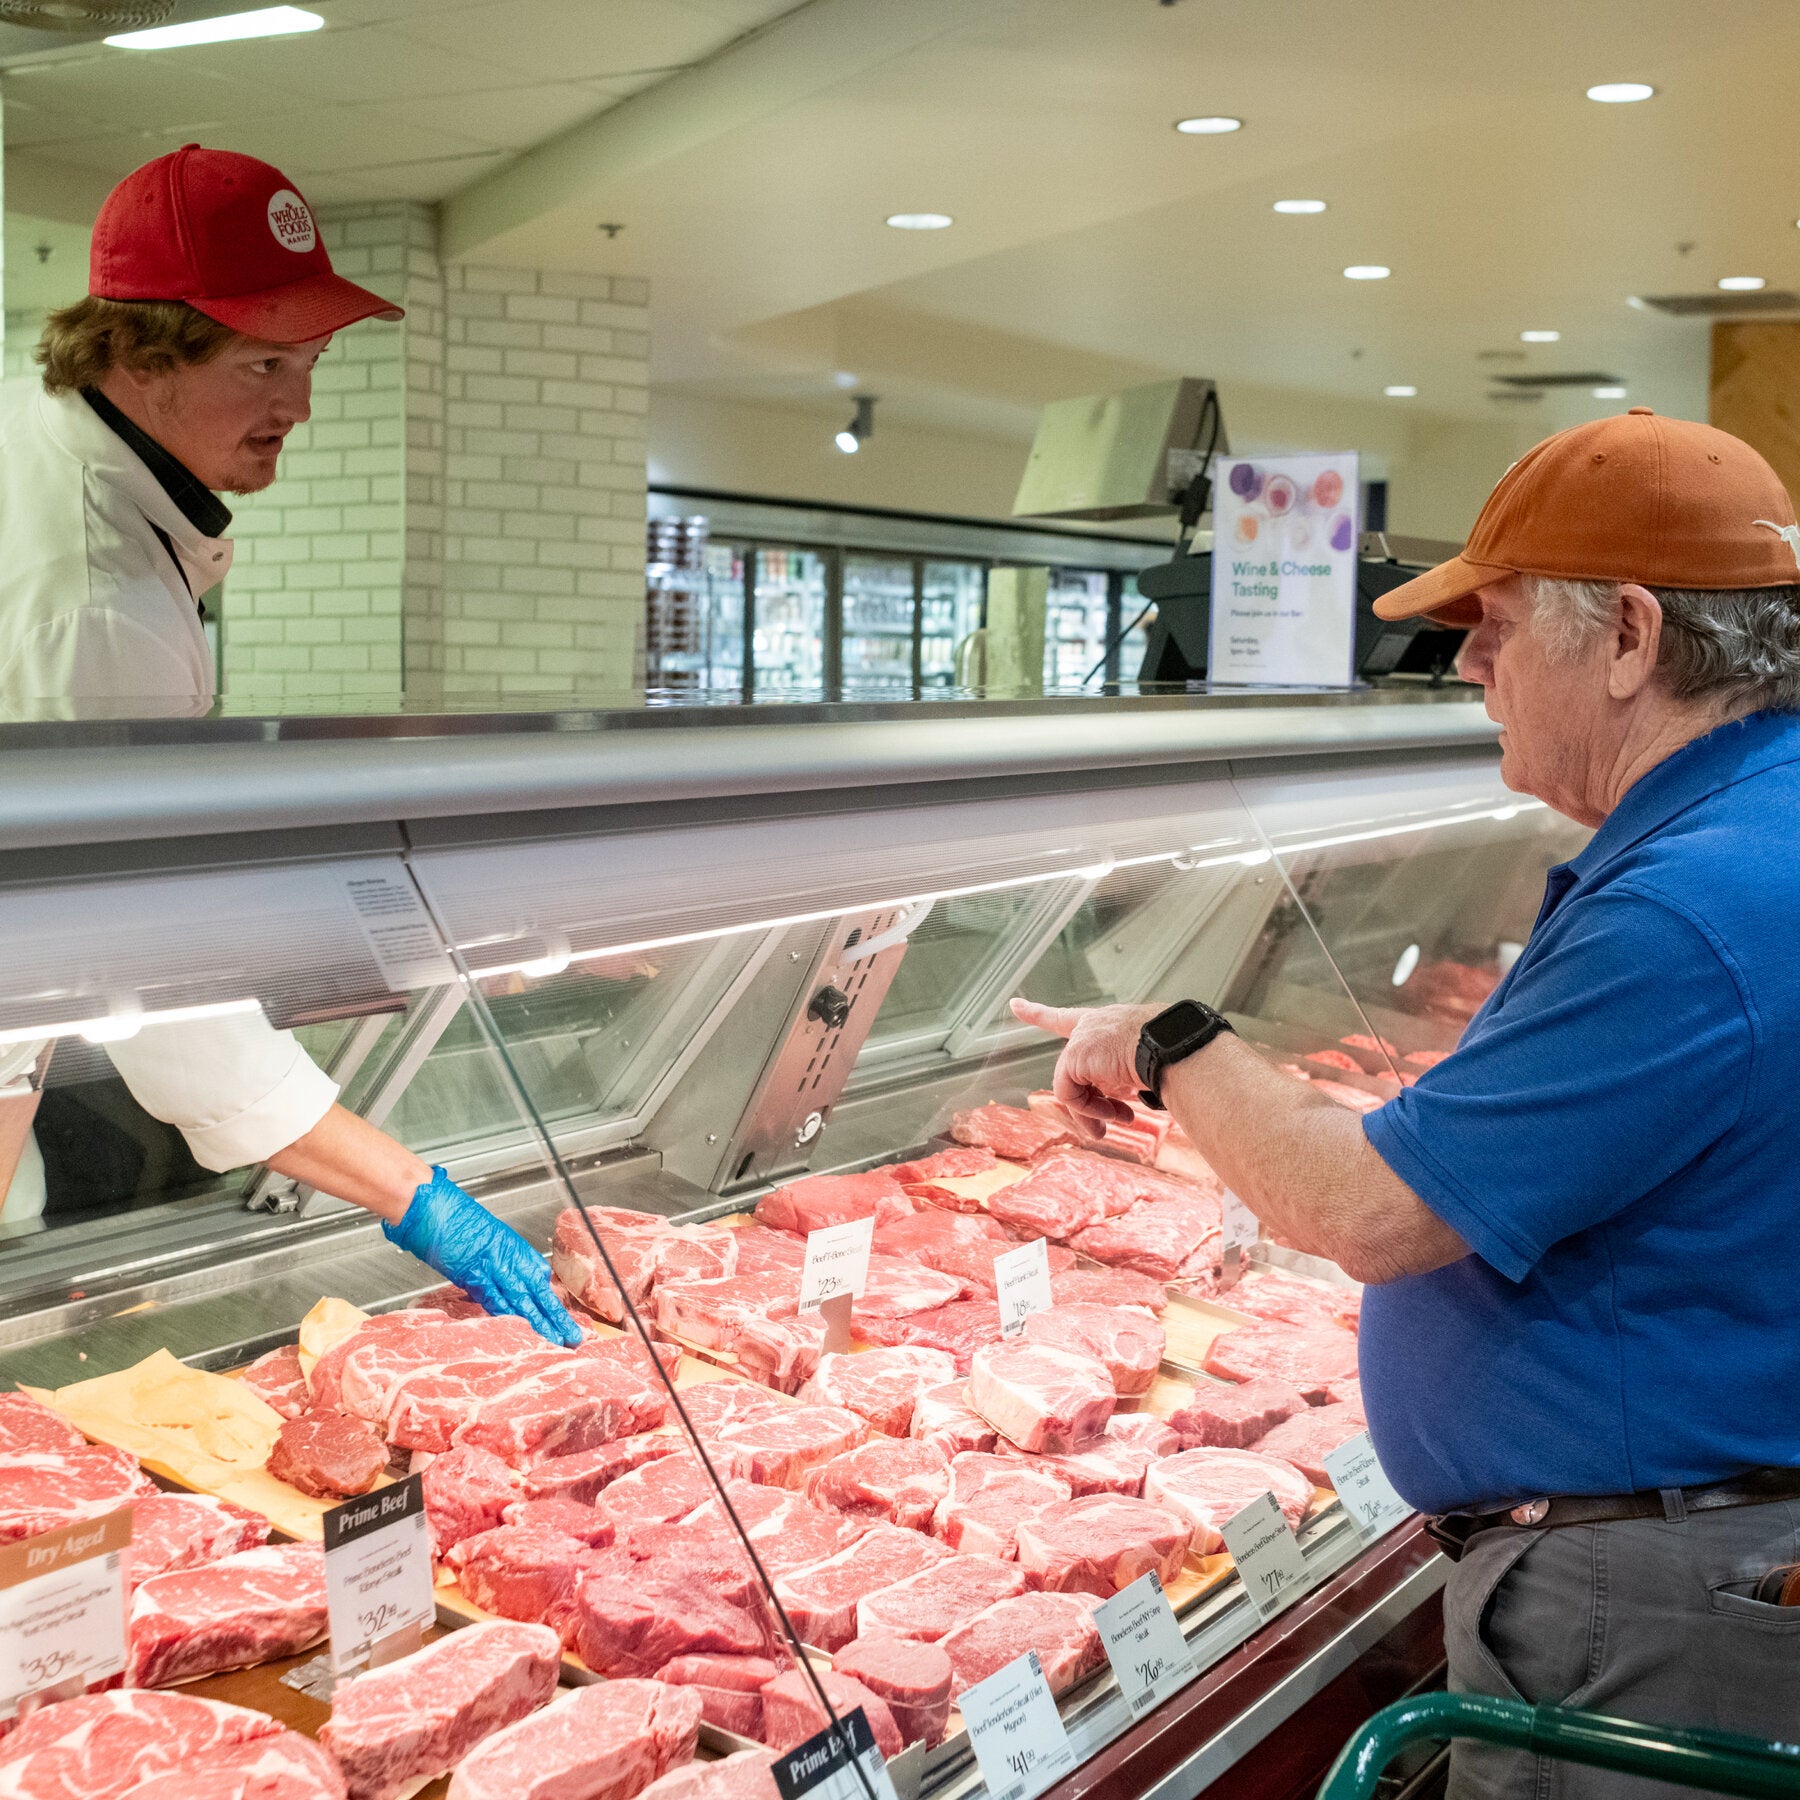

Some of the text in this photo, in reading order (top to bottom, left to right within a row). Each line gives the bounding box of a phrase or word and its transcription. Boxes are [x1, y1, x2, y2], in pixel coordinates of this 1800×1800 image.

[270, 206, 308, 225] WHOLE
[278, 220, 311, 238] FOODS
[287, 234, 311, 245] MARKET
[1232, 561, 1332, 576] Wine & Cheese
[1232, 581, 1279, 600] Tasting
[338, 1485, 410, 1533] Prime Beef
[26, 1524, 106, 1568] Dry Aged
[1111, 1624, 1133, 1644] Boneless
[972, 1721, 988, 1738] Beef
[789, 1720, 857, 1784] Prime Bf
